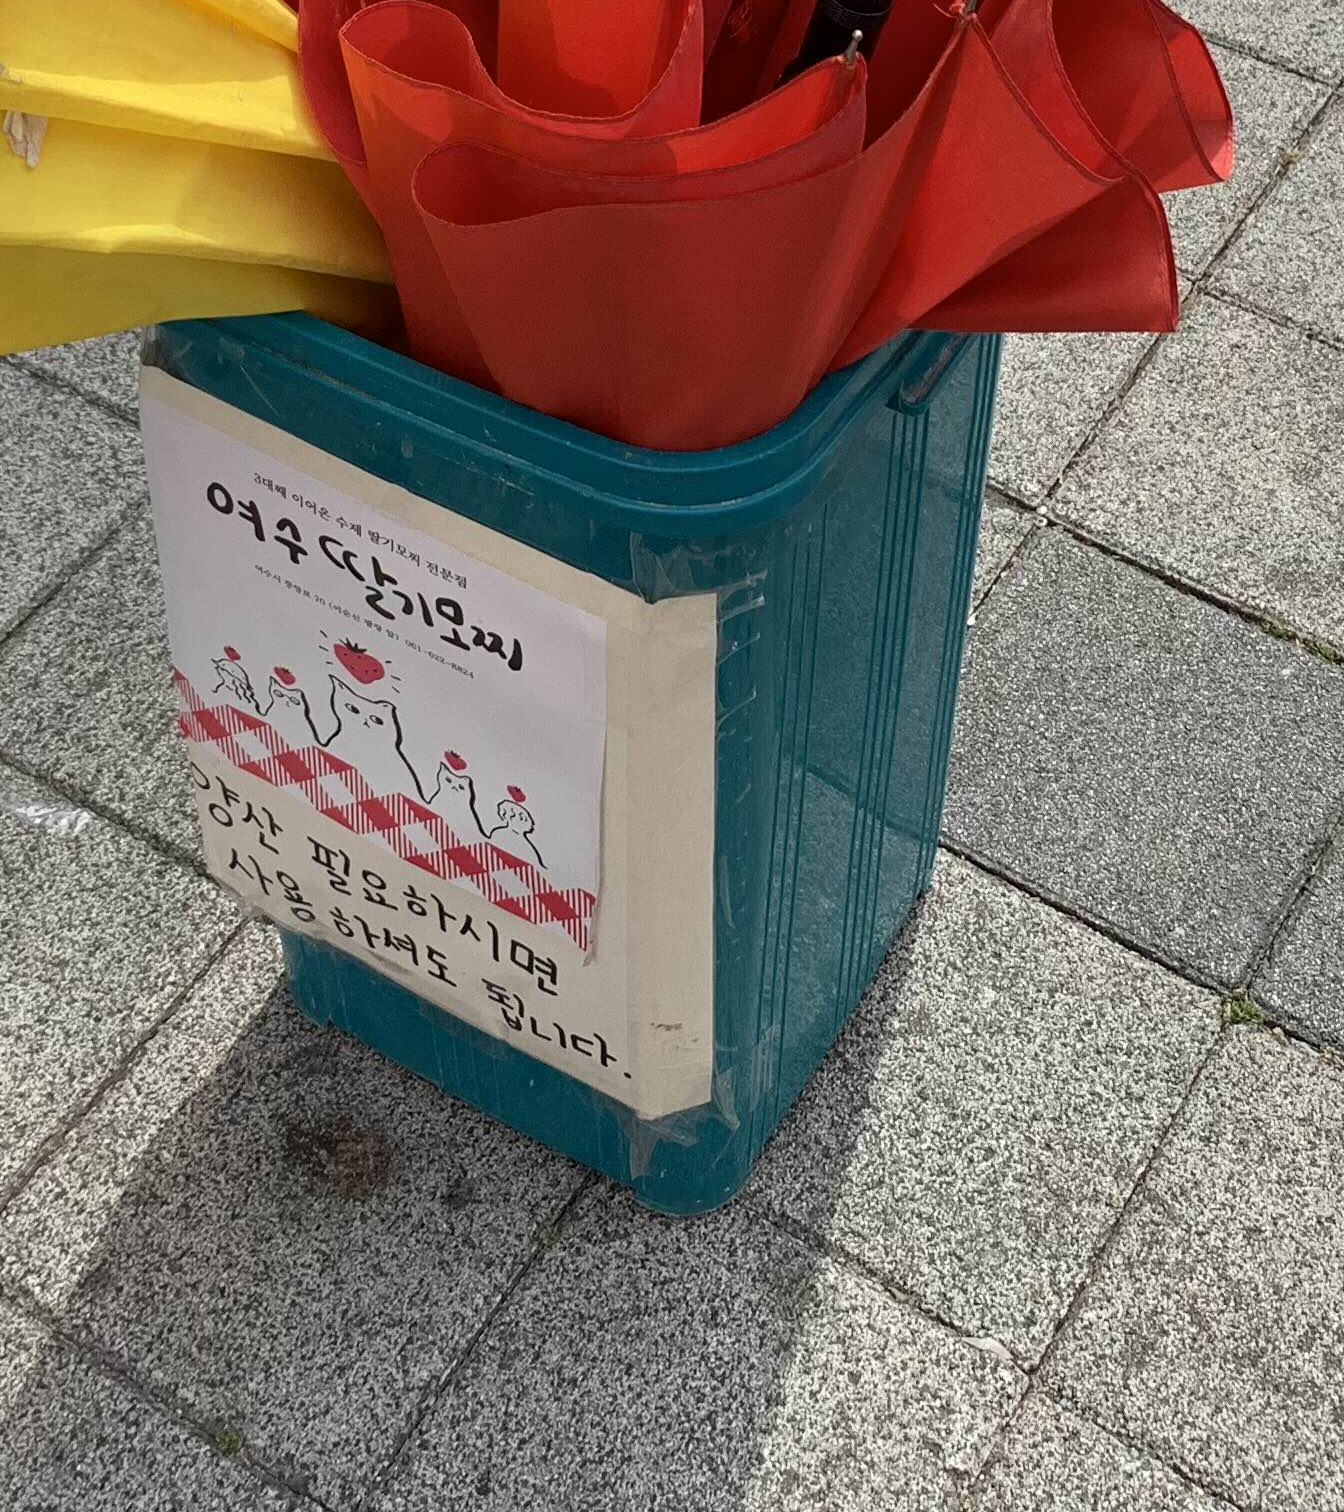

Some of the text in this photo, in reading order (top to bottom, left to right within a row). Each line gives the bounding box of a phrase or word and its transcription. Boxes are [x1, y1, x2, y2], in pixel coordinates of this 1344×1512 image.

[254, 472, 468, 590] 3대째 이어온 수제 딸기모찌 전문점
[190, 760, 559, 997] 양산 필요하시면
[481, 977, 633, 1080] 됩니다.
